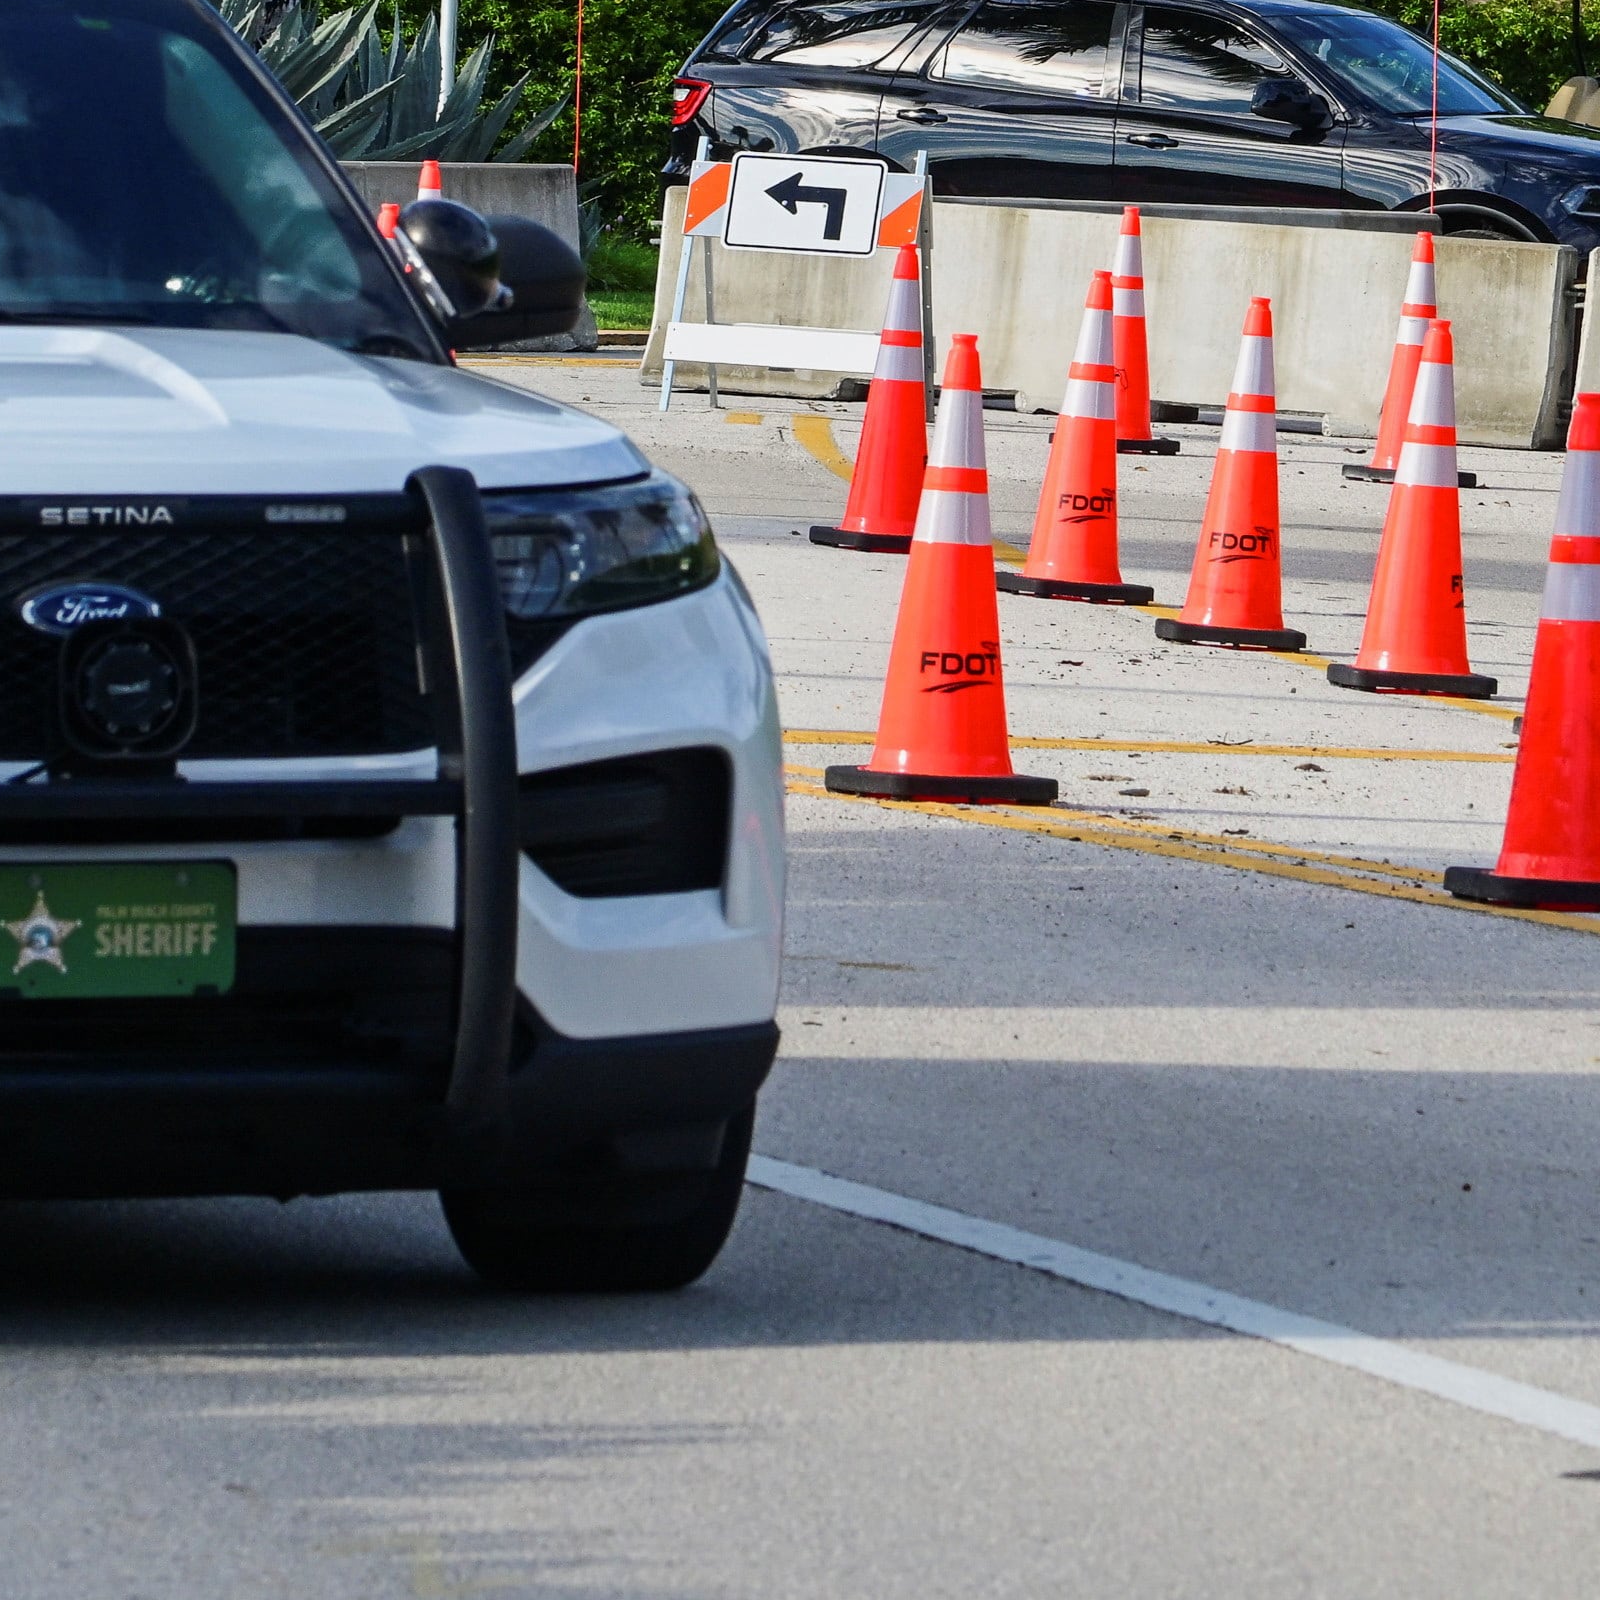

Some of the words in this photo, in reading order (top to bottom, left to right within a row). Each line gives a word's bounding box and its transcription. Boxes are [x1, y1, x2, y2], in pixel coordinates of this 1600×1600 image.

[1058, 493, 1113, 513] FDOT
[40, 505, 173, 526] SETINA
[1209, 532, 1270, 553] FDOT
[55, 596, 128, 624] Ford
[920, 651, 997, 676] FDOT
[95, 921, 218, 957] SHERIFF
